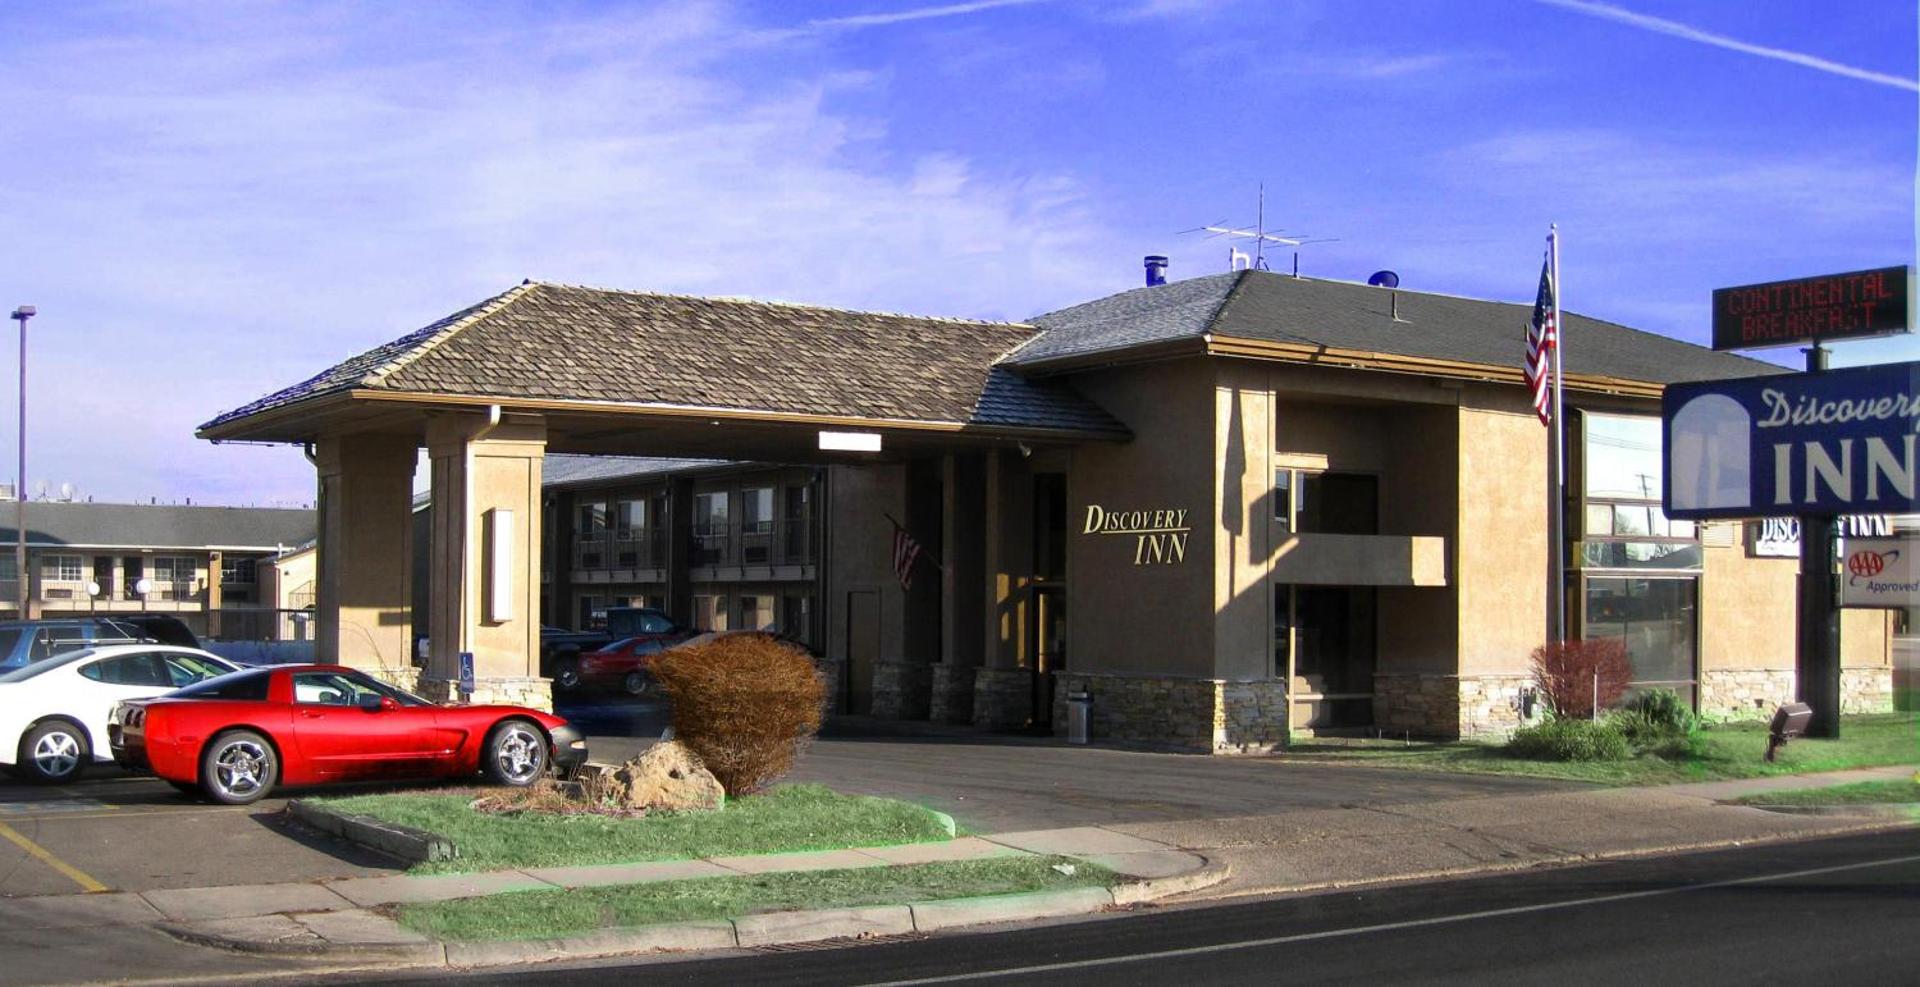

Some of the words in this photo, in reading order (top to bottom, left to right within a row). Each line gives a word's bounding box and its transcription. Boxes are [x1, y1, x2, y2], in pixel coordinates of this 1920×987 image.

[1727, 272, 1893, 316] CONTINENTAL
[1773, 434, 1917, 505] INN
[1083, 504, 1188, 534] DISCOVERY
[1134, 533, 1188, 565] INN
[1850, 551, 1883, 577] AAA
[1866, 579, 1920, 594] Approved
